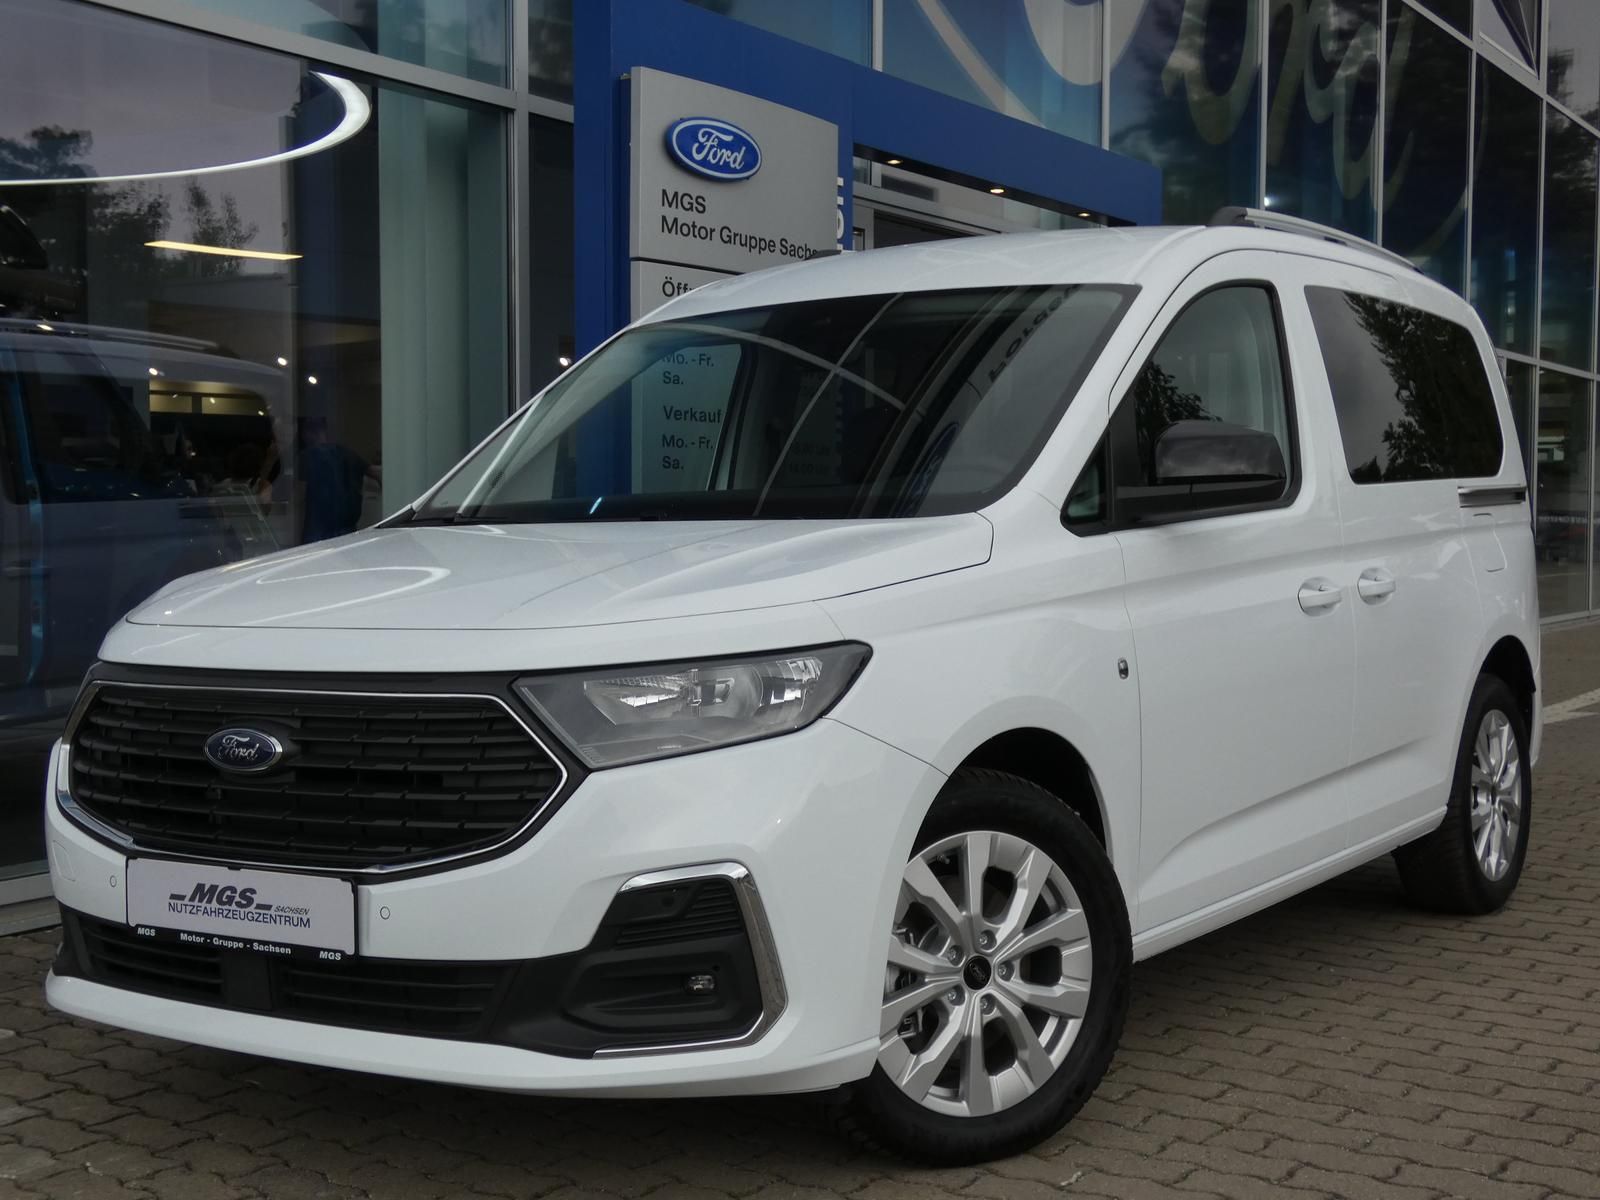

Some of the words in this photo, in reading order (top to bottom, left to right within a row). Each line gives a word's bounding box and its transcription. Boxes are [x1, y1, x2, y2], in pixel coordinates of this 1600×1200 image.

[691, 127, 745, 170] Ford
[661, 188, 707, 214] MGS
[660, 215, 716, 242] Motor
[719, 226, 776, 254] Gruppe
[662, 275, 695, 297] Öff
[663, 370, 684, 385] Sa.
[663, 404, 722, 424] Verkauf
[662, 433, 688, 449] Mo.
[662, 455, 684, 470] Sa.
[217, 734, 260, 761] Ford
[188, 882, 257, 911] MGS
[273, 905, 310, 916] SACHSEN
[168, 901, 311, 929] NUTZFAHRZEUGZENTRUM
[137, 927, 156, 937] MGS
[180, 932, 205, 944] Motor
[212, 936, 244, 950] Gruppe
[253, 942, 292, 955] Sachsen
[319, 950, 342, 961] MGS
